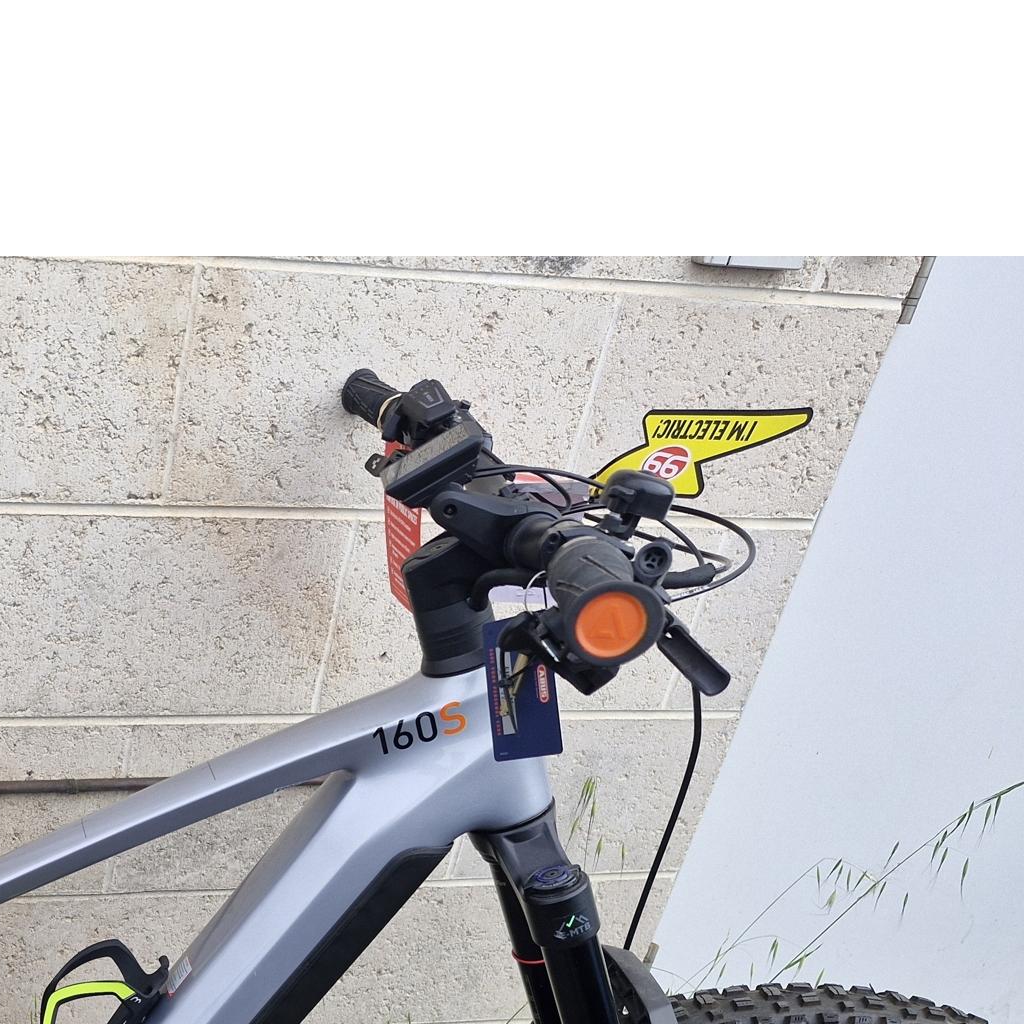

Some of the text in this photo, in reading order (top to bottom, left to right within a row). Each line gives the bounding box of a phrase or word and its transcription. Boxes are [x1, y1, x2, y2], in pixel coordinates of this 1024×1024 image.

[651, 419, 758, 441] I'M ELECTRIC!
[538, 670, 548, 698] ABUS
[372, 701, 467, 755] 160S
